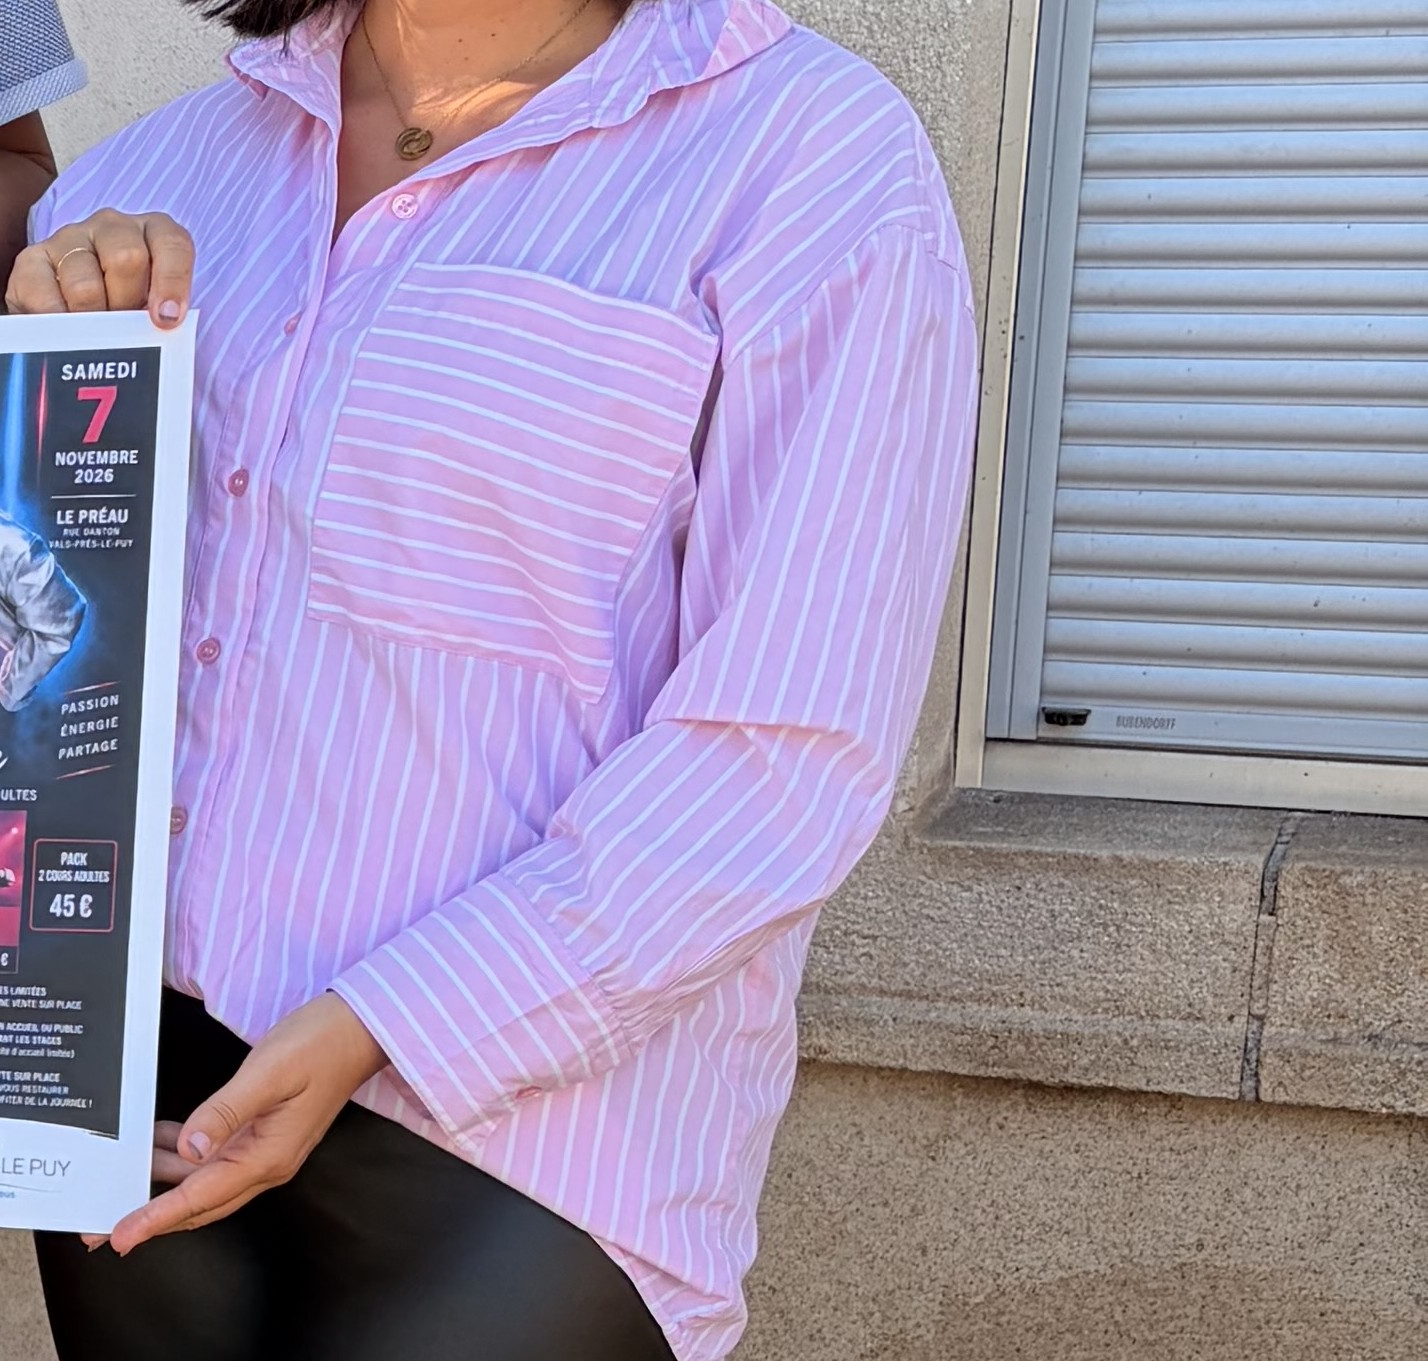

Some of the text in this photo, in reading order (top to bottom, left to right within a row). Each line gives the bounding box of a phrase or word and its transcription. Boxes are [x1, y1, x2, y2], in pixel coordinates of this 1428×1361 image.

[61, 361, 137, 381] SAMEDI
[77, 385, 118, 444] 7
[55, 449, 139, 466] NOVEMBRE
[74, 468, 114, 484] 2026
[56, 506, 129, 525] LE PRÉAU
[60, 694, 119, 715] PASSION
[60, 716, 119, 737] ÉNERGIE
[58, 738, 118, 760] PARTAGE
[60, 851, 88, 866] PACK
[49, 893, 93, 918] 45 €
[0, 952, 9, 967] €
[29, 1158, 72, 1177] PUY
